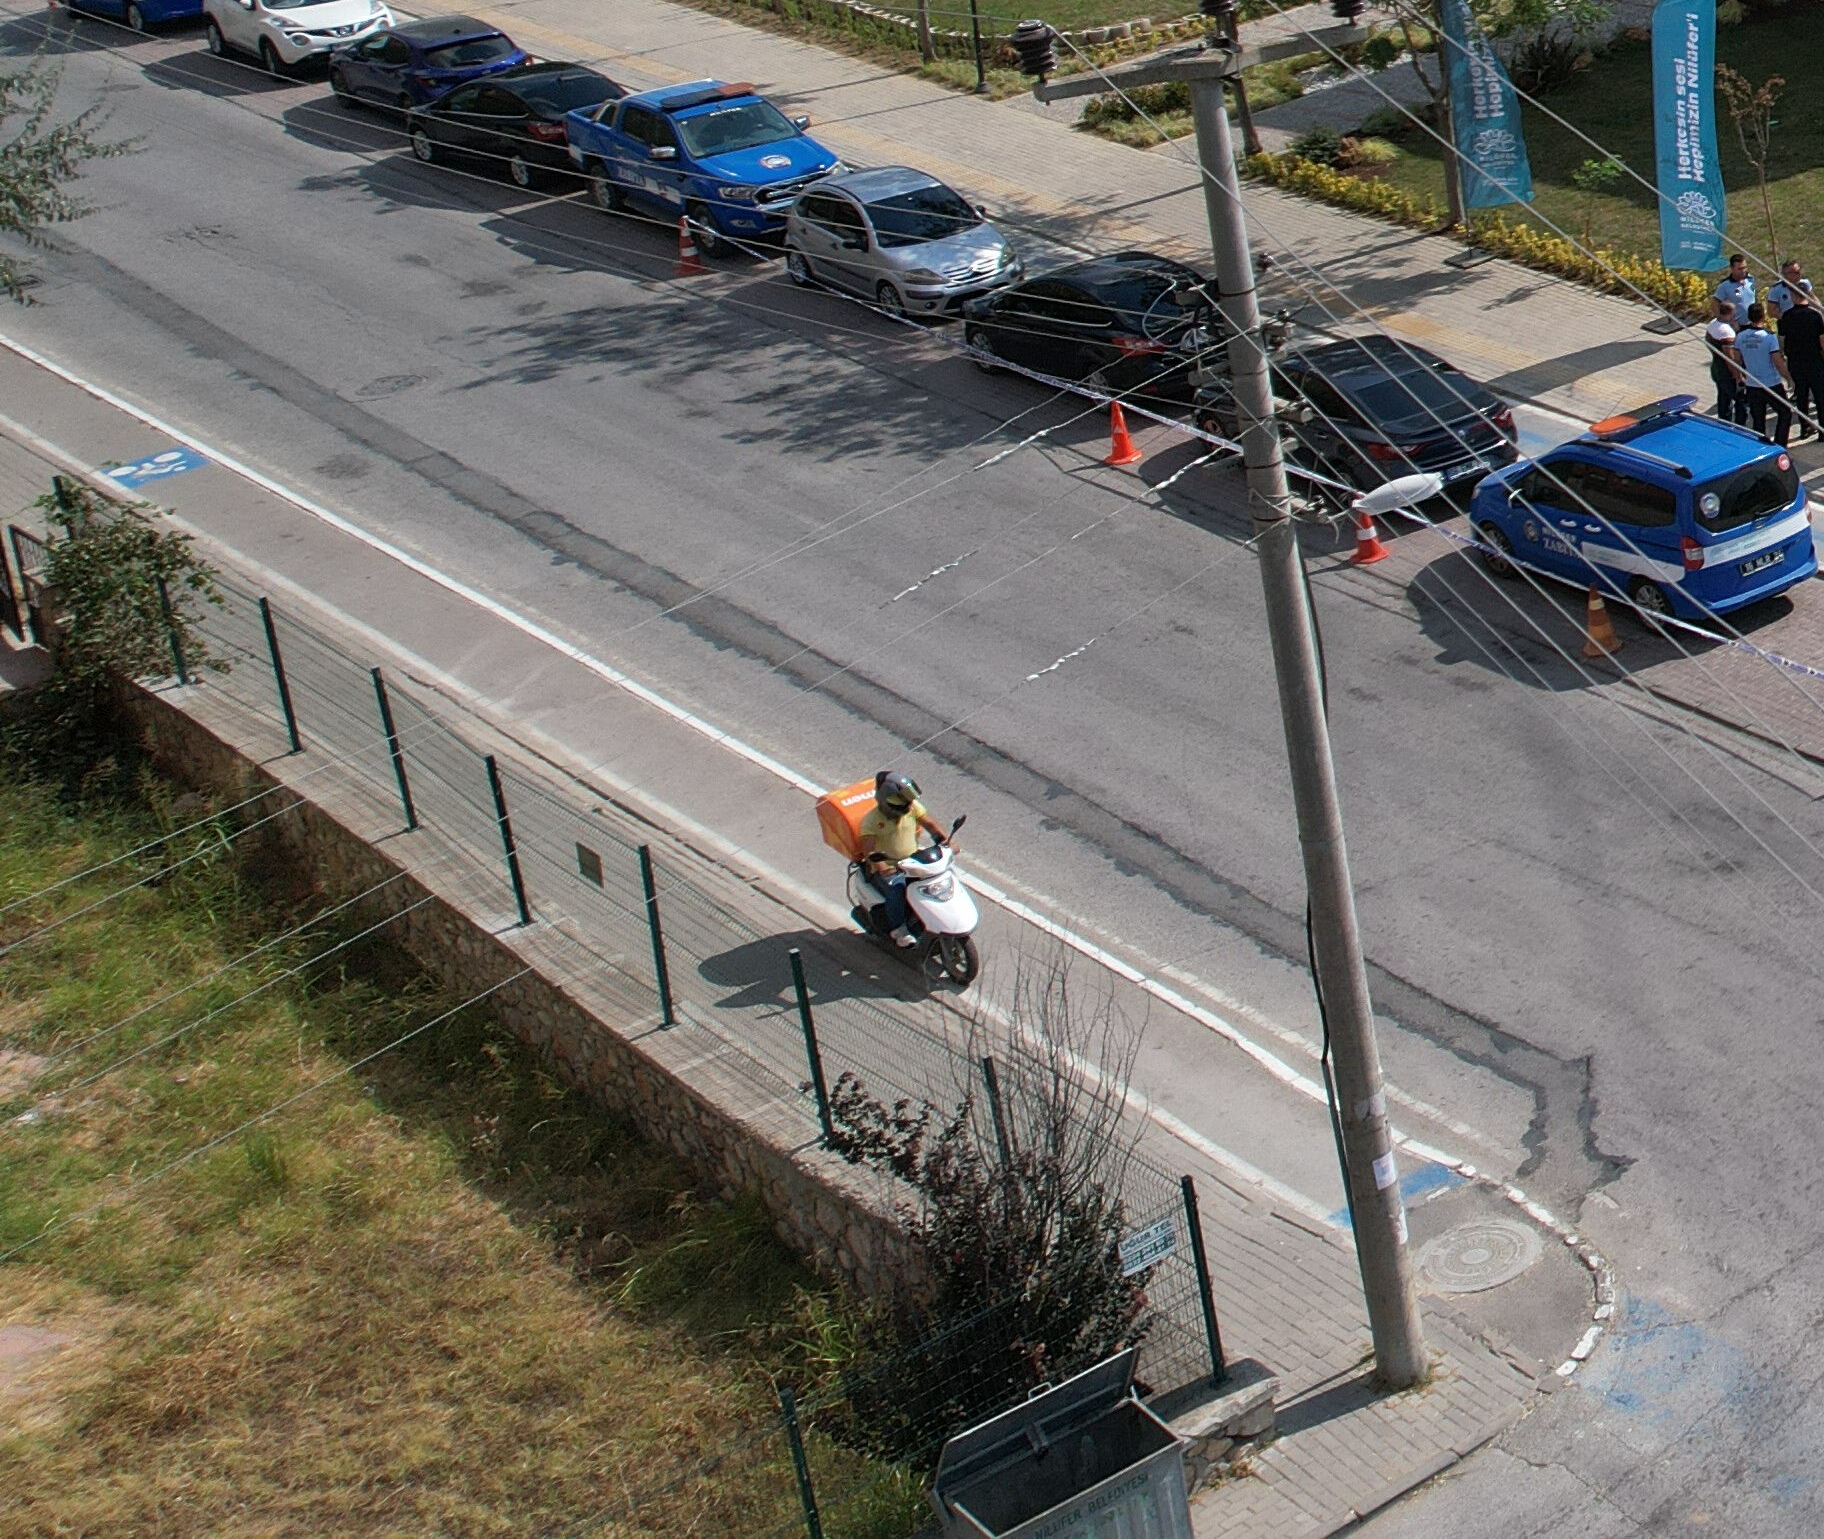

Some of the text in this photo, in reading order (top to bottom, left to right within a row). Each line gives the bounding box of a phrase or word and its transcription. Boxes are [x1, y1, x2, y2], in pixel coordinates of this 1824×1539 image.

[1674, 58, 1692, 180] Herkesin sesi
[1686, 92, 1706, 183] Hepimizin
